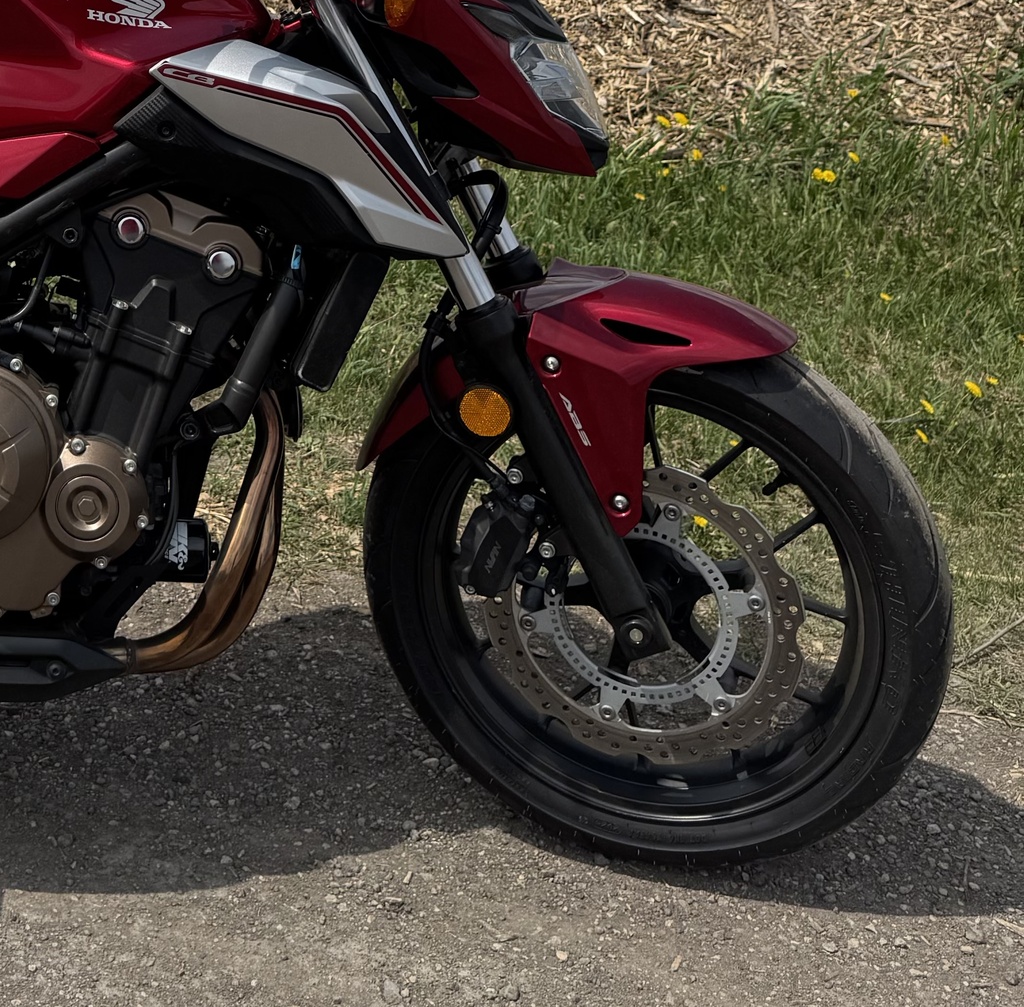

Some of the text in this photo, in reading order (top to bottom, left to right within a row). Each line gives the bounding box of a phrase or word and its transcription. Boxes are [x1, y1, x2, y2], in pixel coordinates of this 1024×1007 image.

[86, 8, 173, 29] HONDA
[163, 68, 215, 85] CB
[559, 392, 592, 447] ABS
